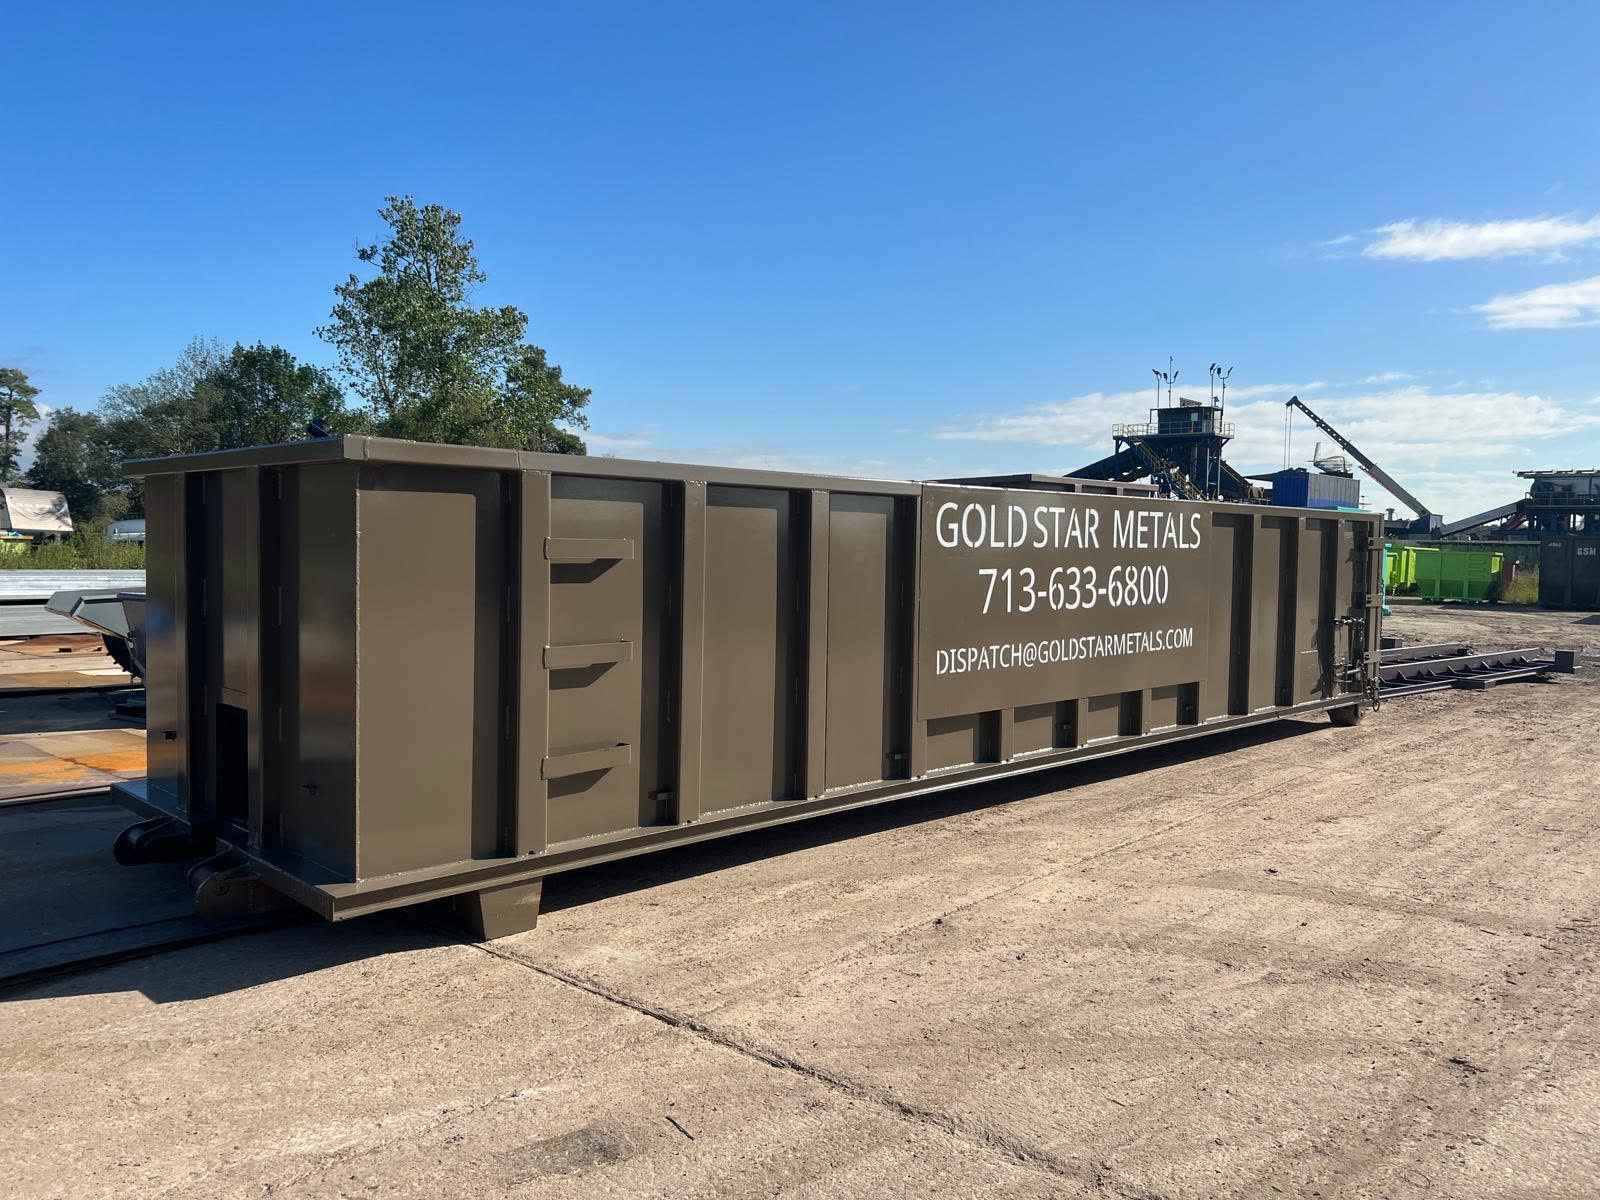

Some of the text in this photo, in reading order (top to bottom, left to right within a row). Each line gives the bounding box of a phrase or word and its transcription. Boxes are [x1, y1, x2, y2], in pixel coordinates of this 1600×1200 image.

[935, 501, 1202, 550] GOLD STAR METALS
[1577, 547, 1597, 556] GSM
[978, 564, 1169, 615] 713-633-6800
[936, 627, 1194, 676] DISPATCH@GOLDSTARMETALS.COM
